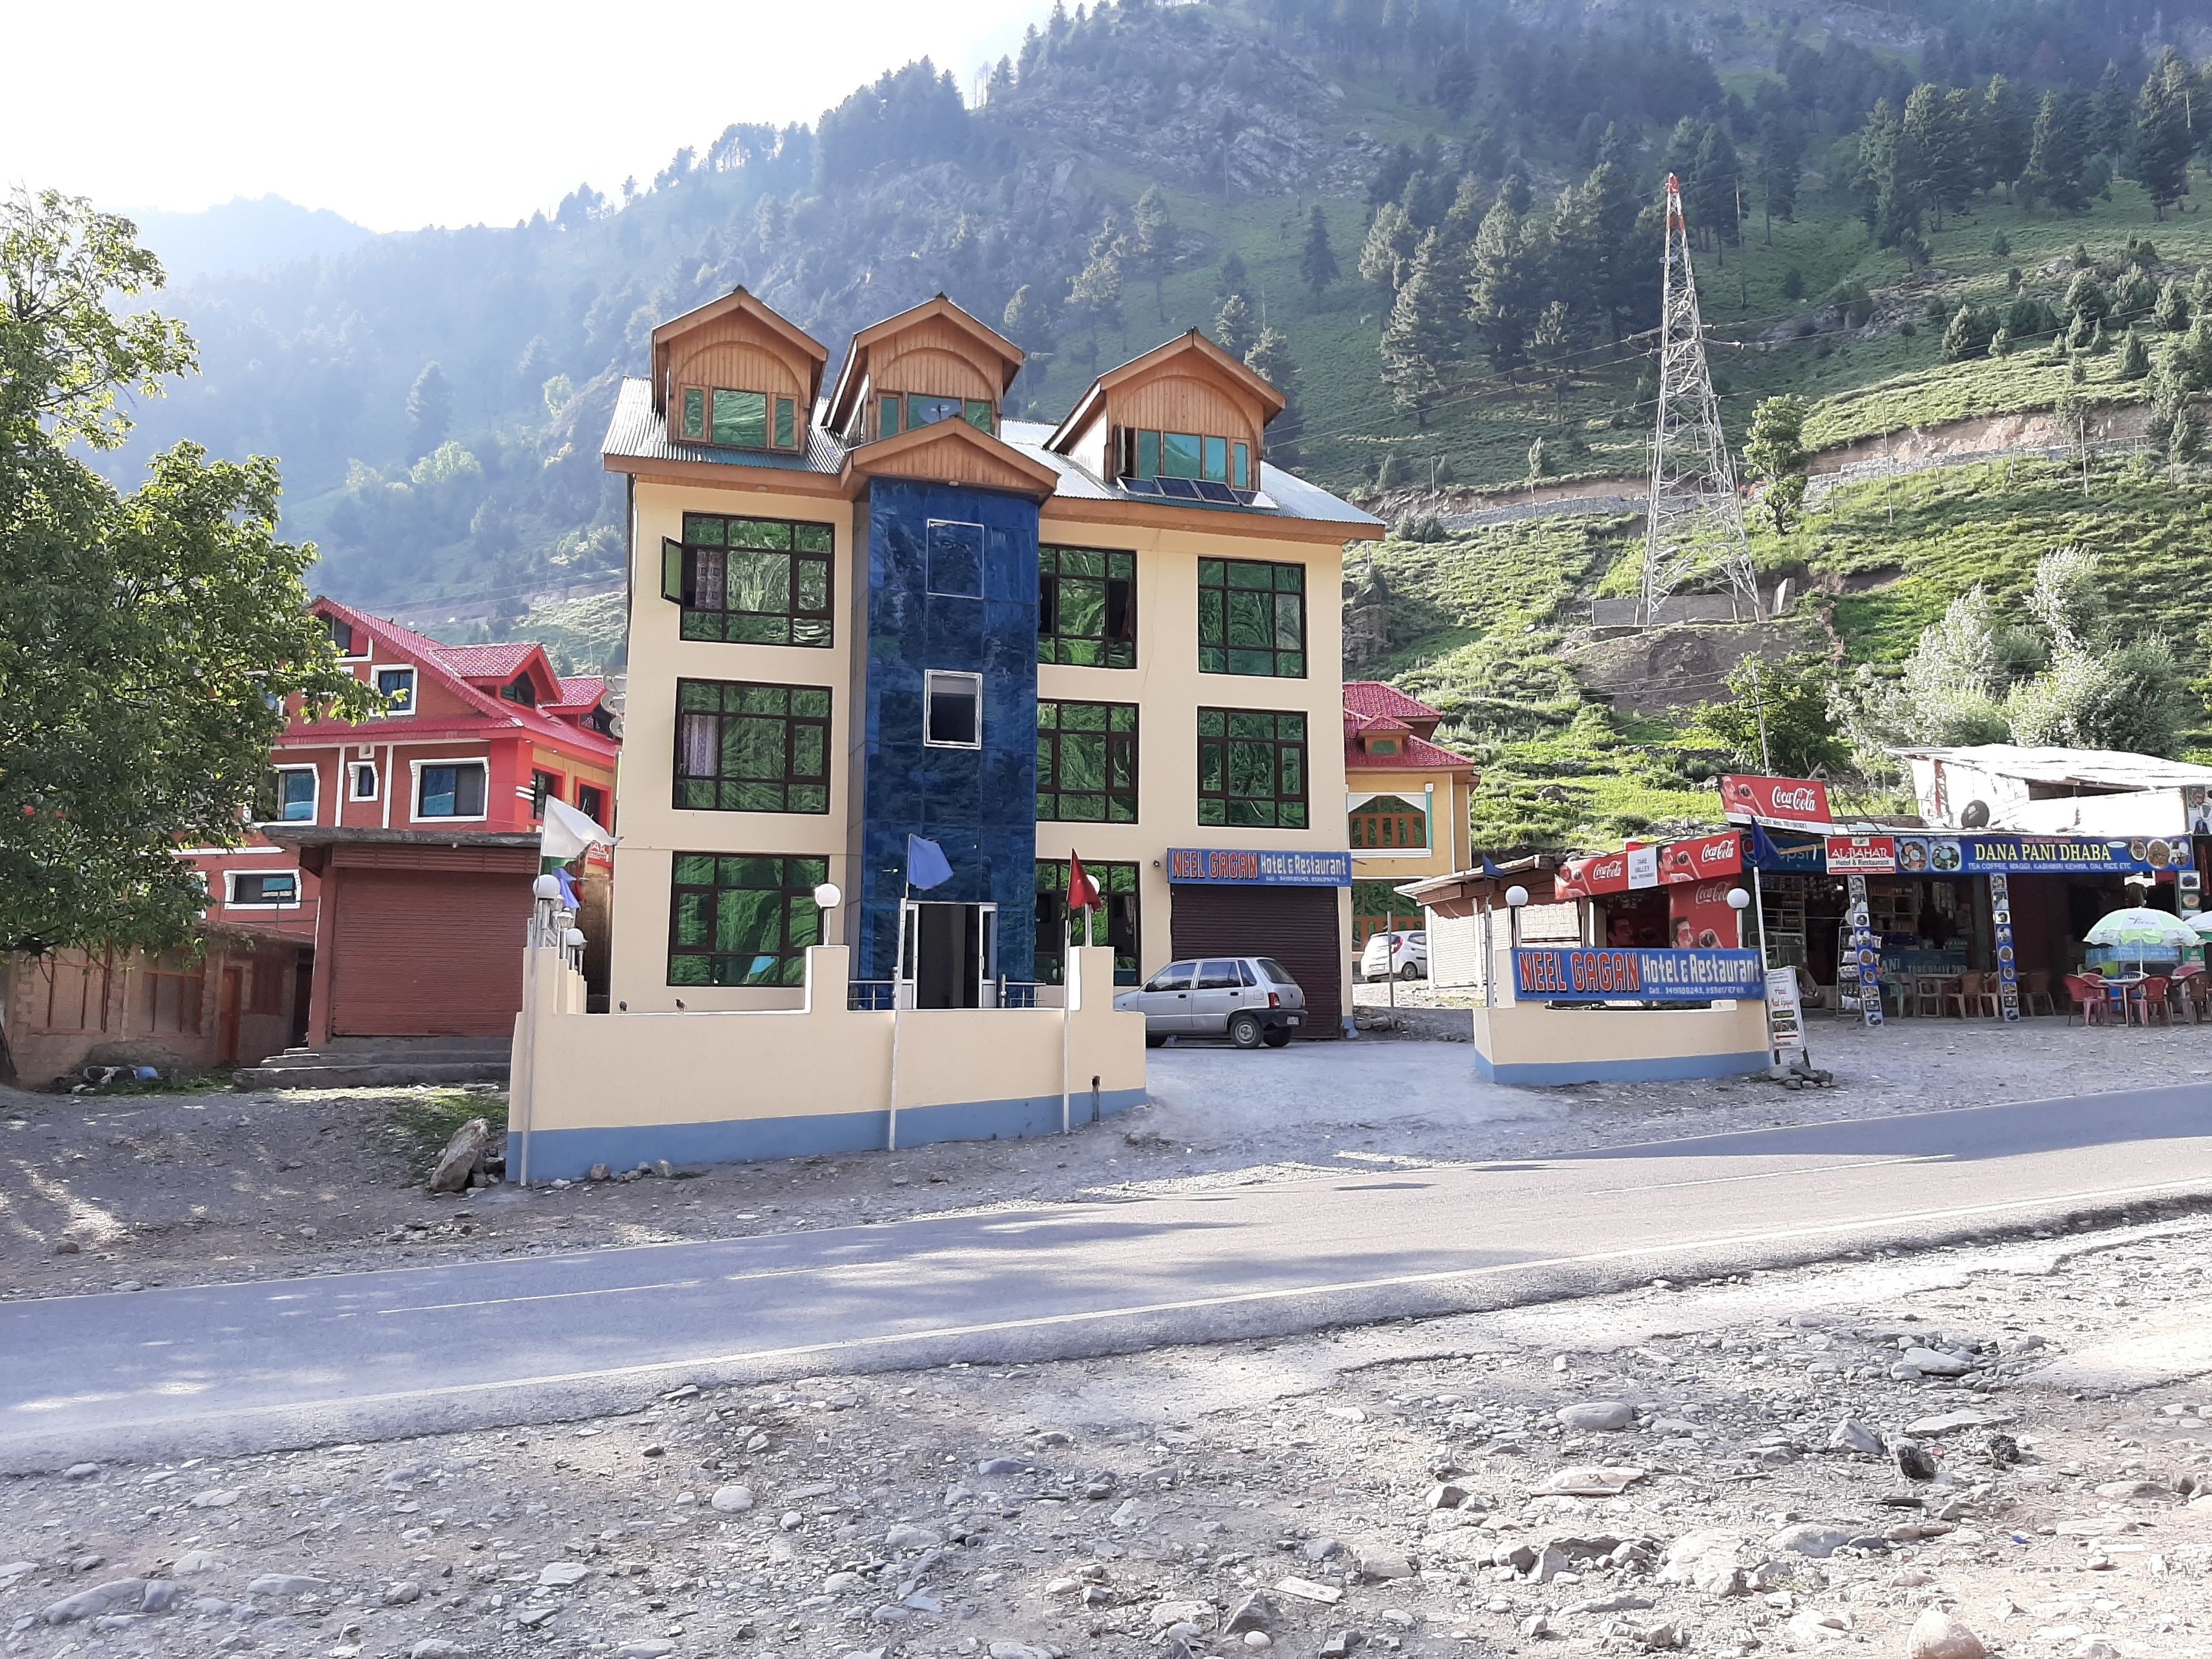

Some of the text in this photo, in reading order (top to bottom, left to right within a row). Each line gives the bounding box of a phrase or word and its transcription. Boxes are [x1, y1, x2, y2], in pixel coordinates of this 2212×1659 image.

[1172, 851, 1206, 877] NEEL
[1209, 851, 1258, 878] GAGAN
[1260, 853, 1287, 874] Hotel
[1294, 854, 1347, 875] Restaurant
[1974, 843, 2111, 861] DANA PANI DHABA
[1696, 881, 1732, 904] Coca-Col
[1518, 952, 1567, 991] NEEL
[1570, 952, 1640, 991] GAGAN
[1642, 953, 1679, 983] Hotel
[1689, 953, 1761, 983] Restaurant
